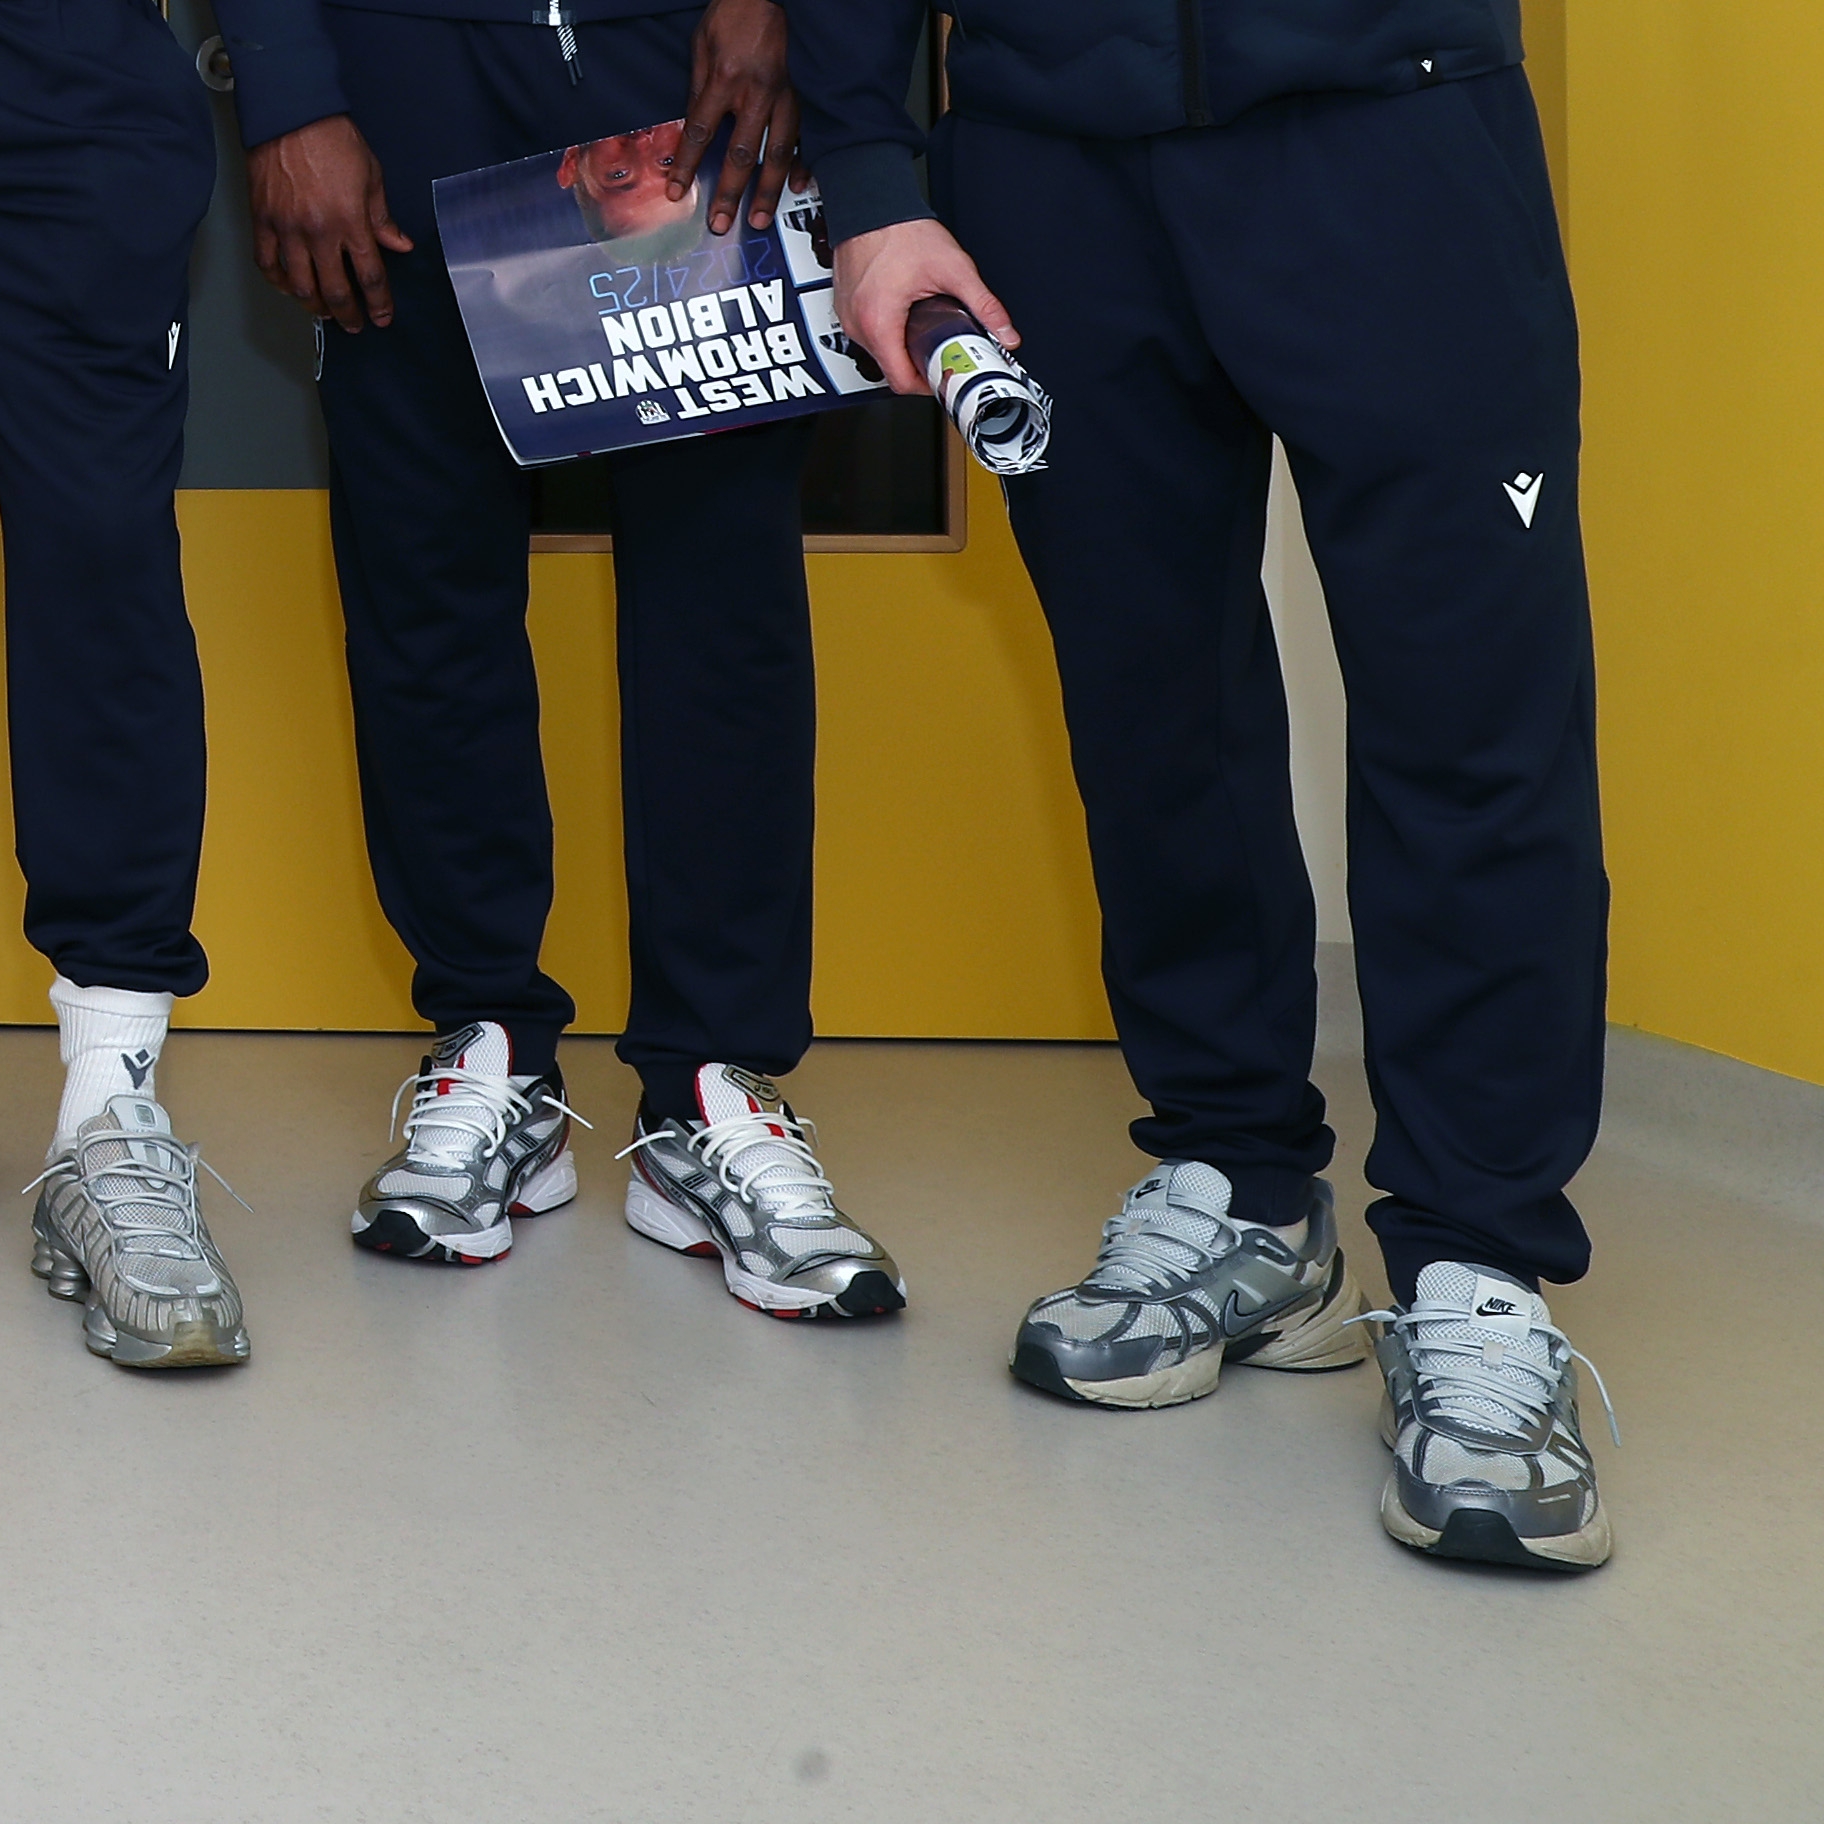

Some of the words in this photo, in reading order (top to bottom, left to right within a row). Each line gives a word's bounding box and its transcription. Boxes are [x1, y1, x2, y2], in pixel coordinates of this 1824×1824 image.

[588, 237, 777, 315] 2024/25
[601, 278, 784, 356] ALBION
[521, 322, 807, 413] BROMWICH
[674, 364, 826, 420] WEST
[1484, 1296, 1517, 1313] NIKE
